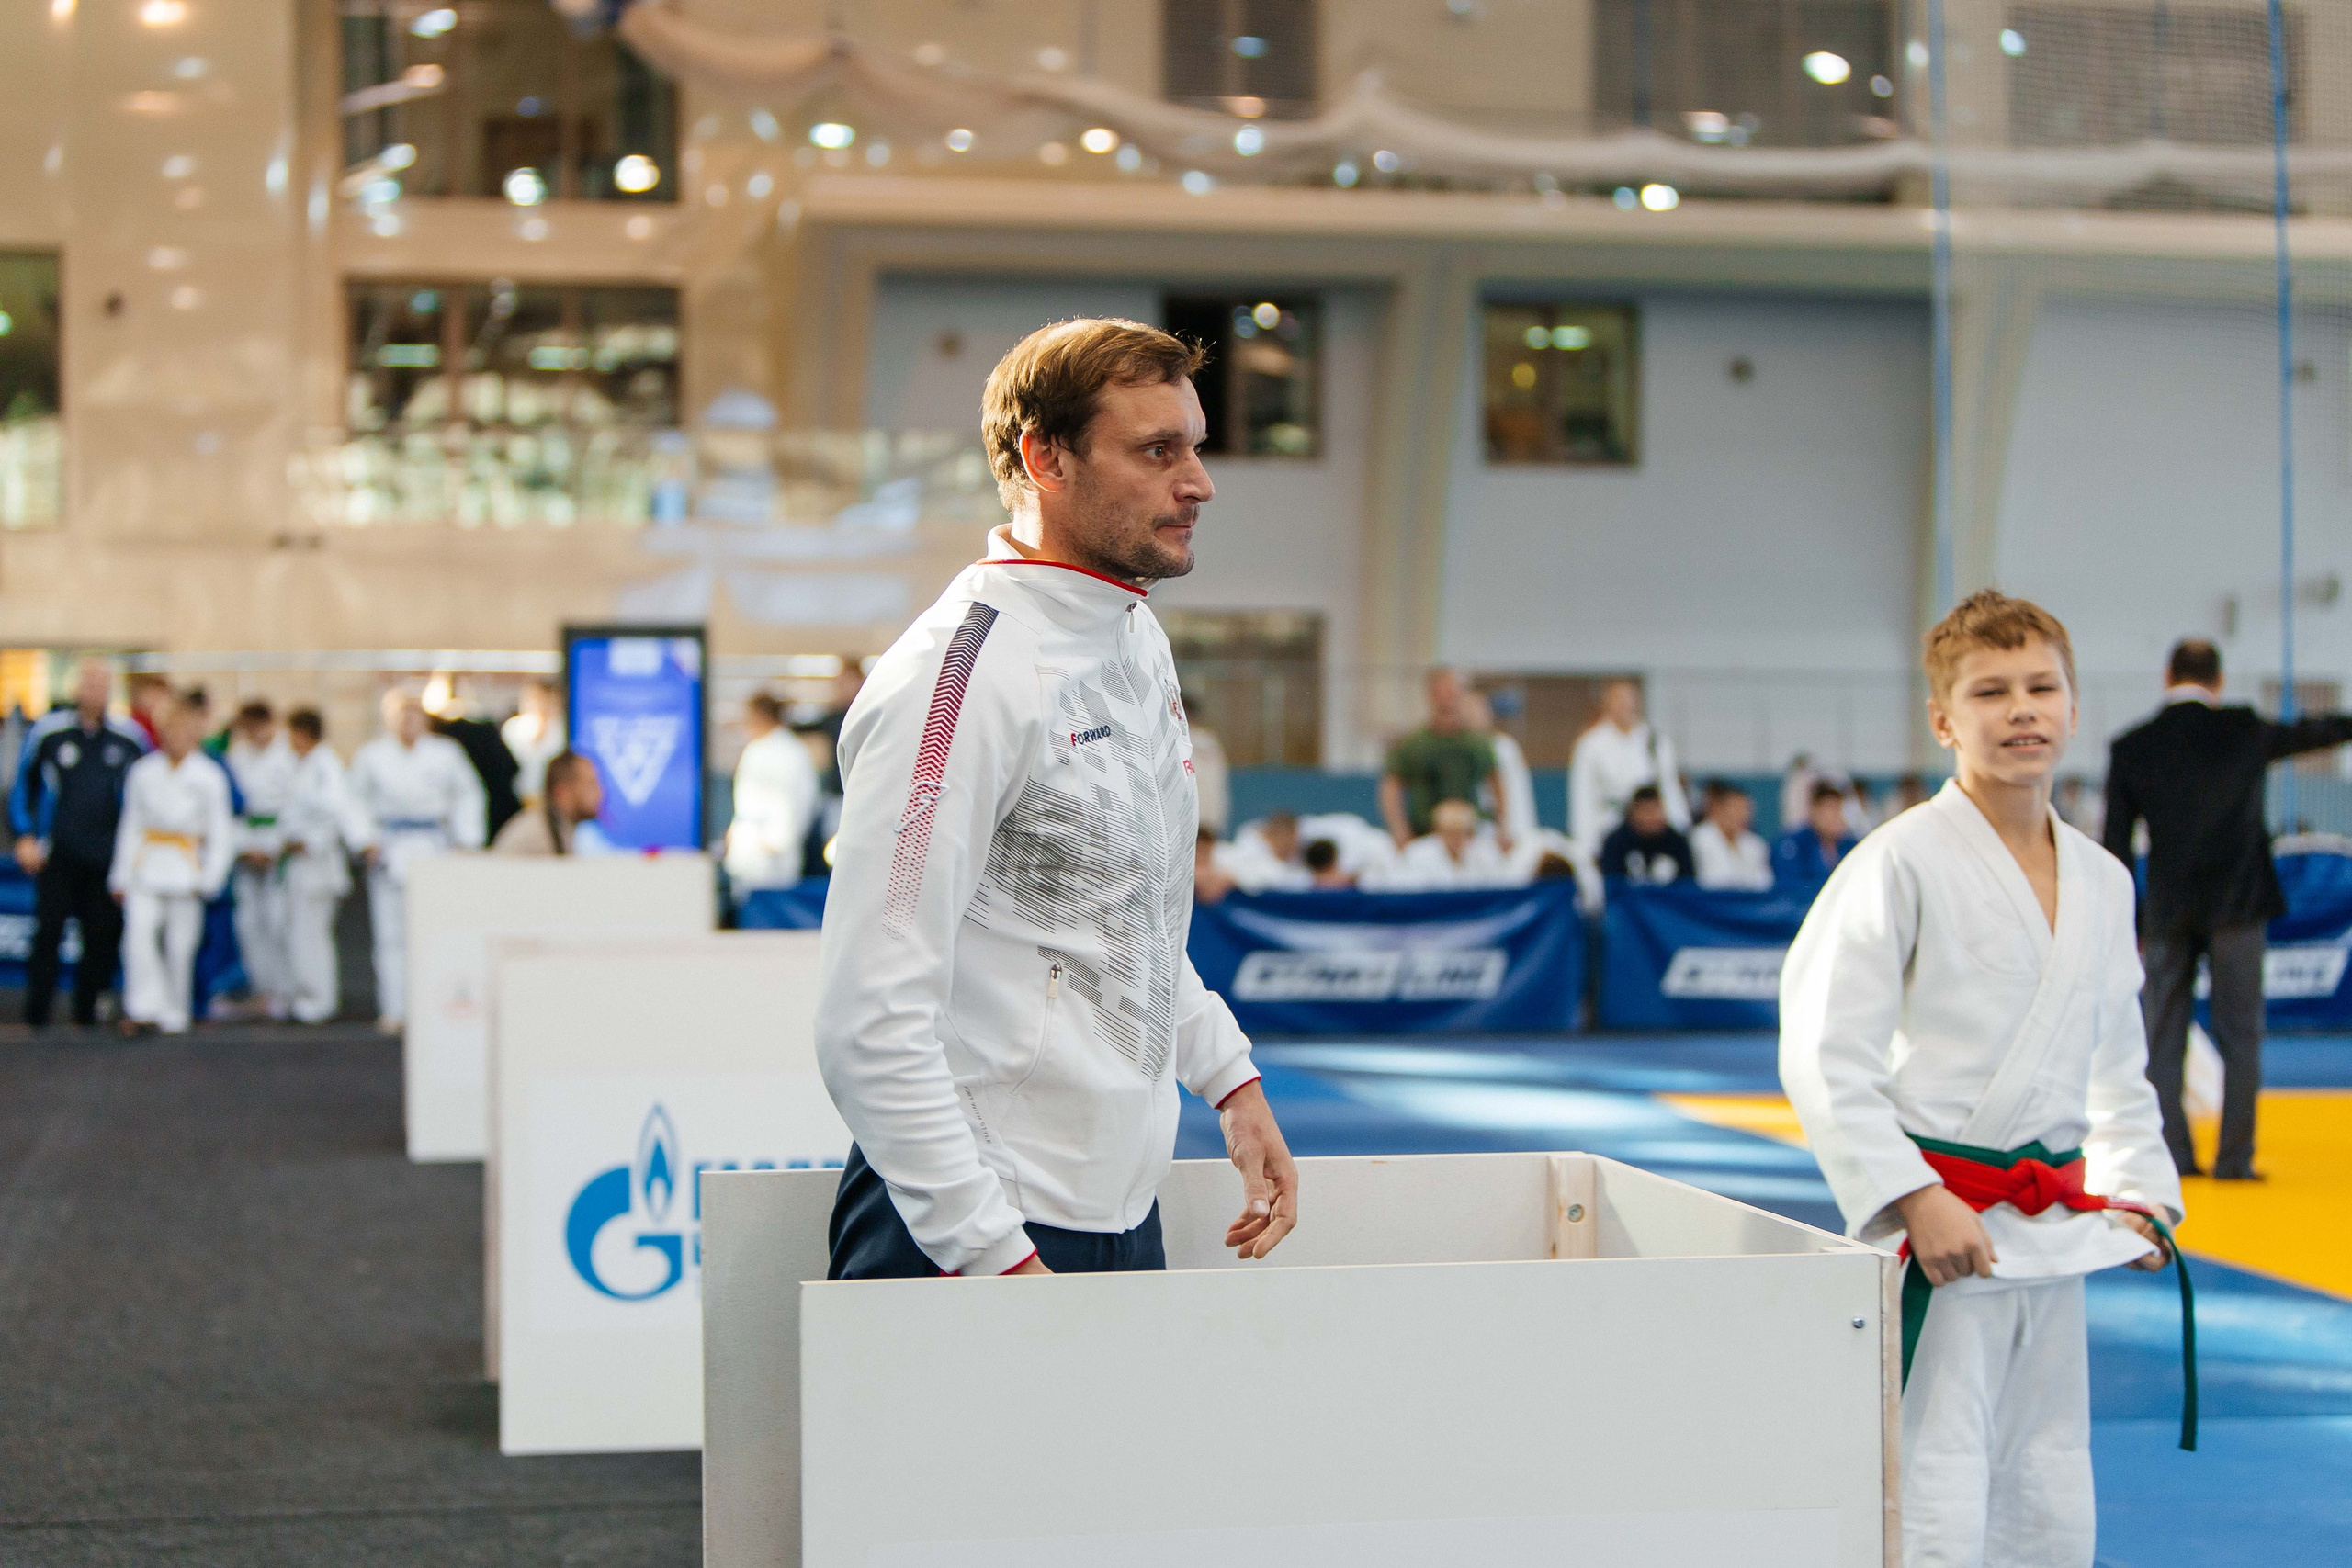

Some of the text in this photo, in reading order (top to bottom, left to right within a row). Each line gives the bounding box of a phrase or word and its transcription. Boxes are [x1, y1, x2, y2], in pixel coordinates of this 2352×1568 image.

[1070, 725, 1111, 746] FORWARD
[971, 1103, 982, 1120] WITH
[980, 1122, 991, 1144] STYLE
